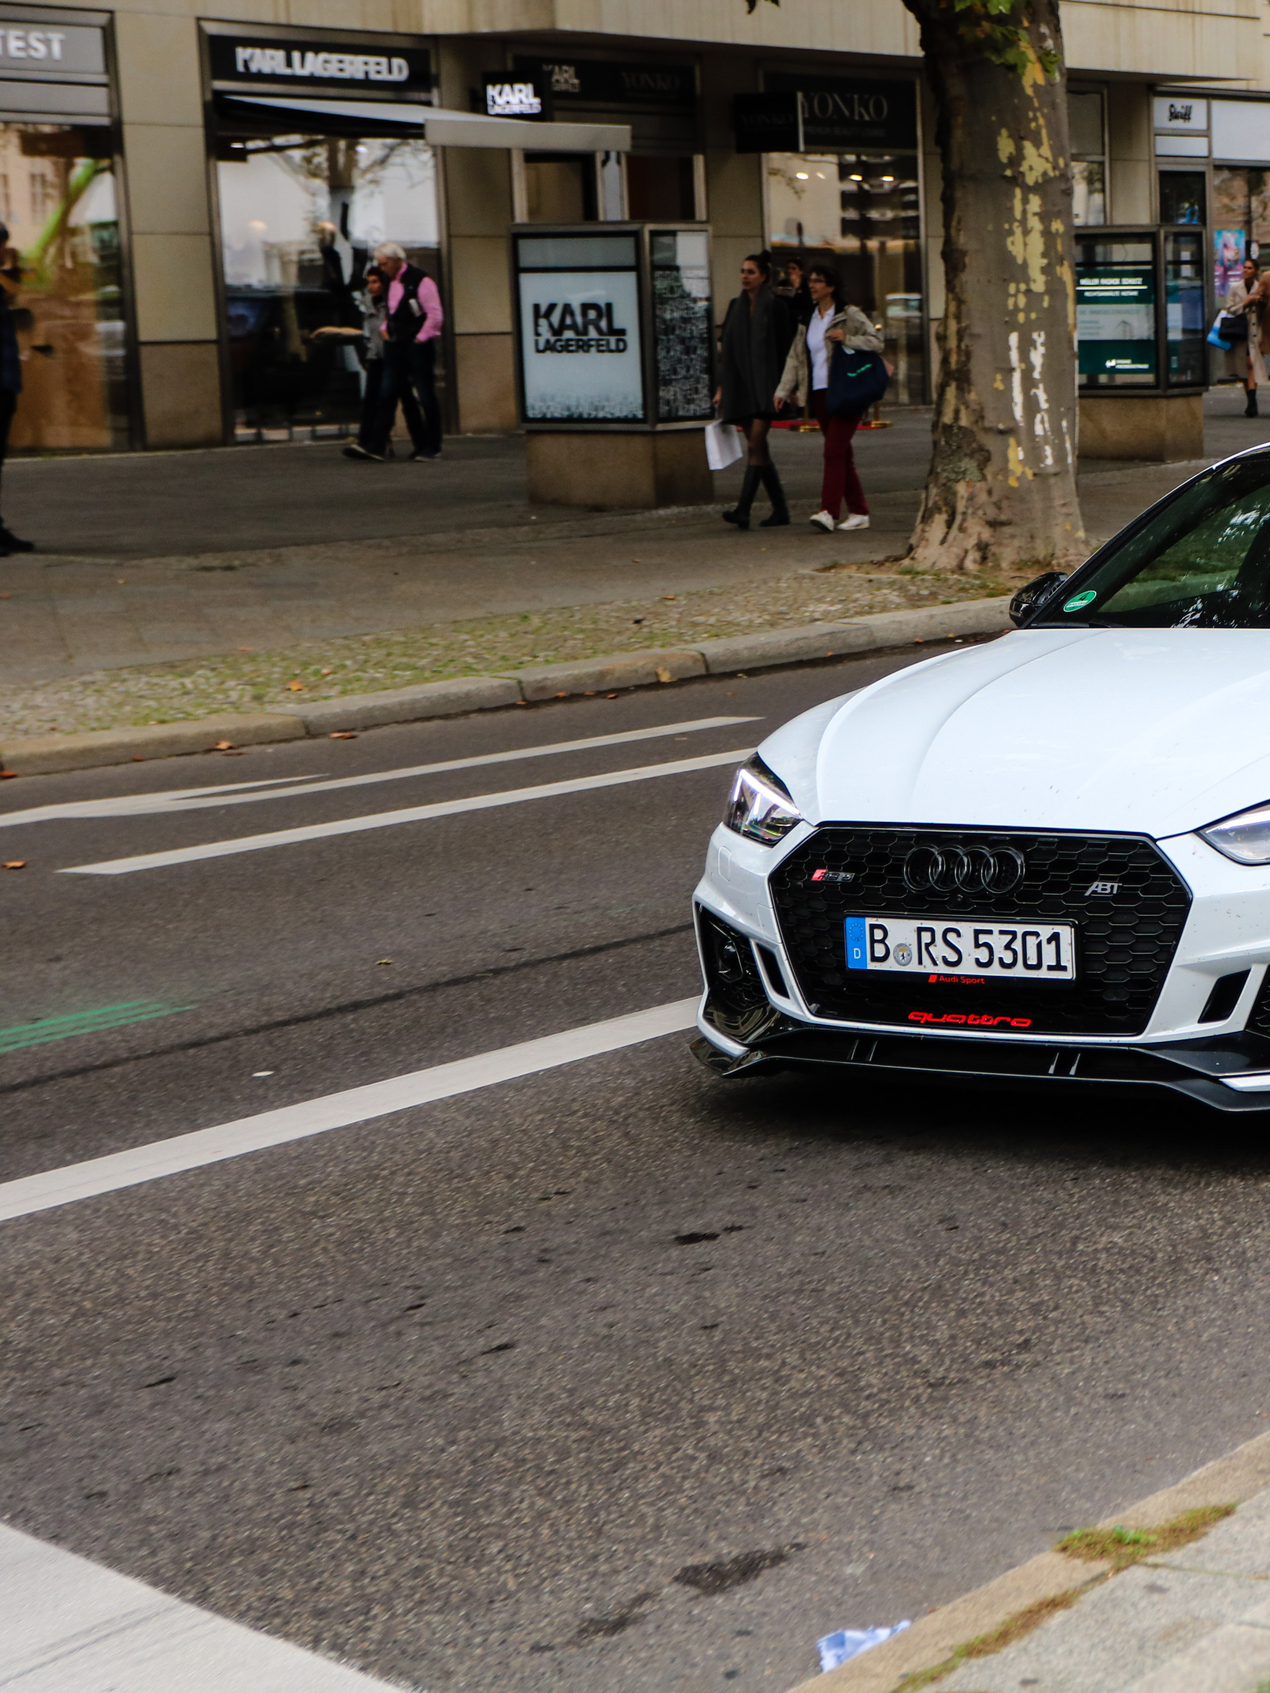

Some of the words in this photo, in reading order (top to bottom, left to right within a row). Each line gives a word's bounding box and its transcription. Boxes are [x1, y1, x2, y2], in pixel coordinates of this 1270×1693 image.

[235, 46, 292, 76] KARL
[291, 51, 409, 82] LAGERFELD
[486, 83, 541, 104] KARL
[487, 103, 542, 115] LAGERFELD
[532, 302, 627, 337] KARL
[534, 338, 628, 354] LAGERFELD
[1085, 881, 1123, 896] ABT
[853, 948, 861, 959] D
[868, 923, 891, 963] B
[916, 926, 963, 968] RS
[973, 929, 1068, 972] 5301
[939, 975, 959, 983] Audi
[960, 976, 985, 985] Sport
[908, 1011, 1032, 1028] quattro
